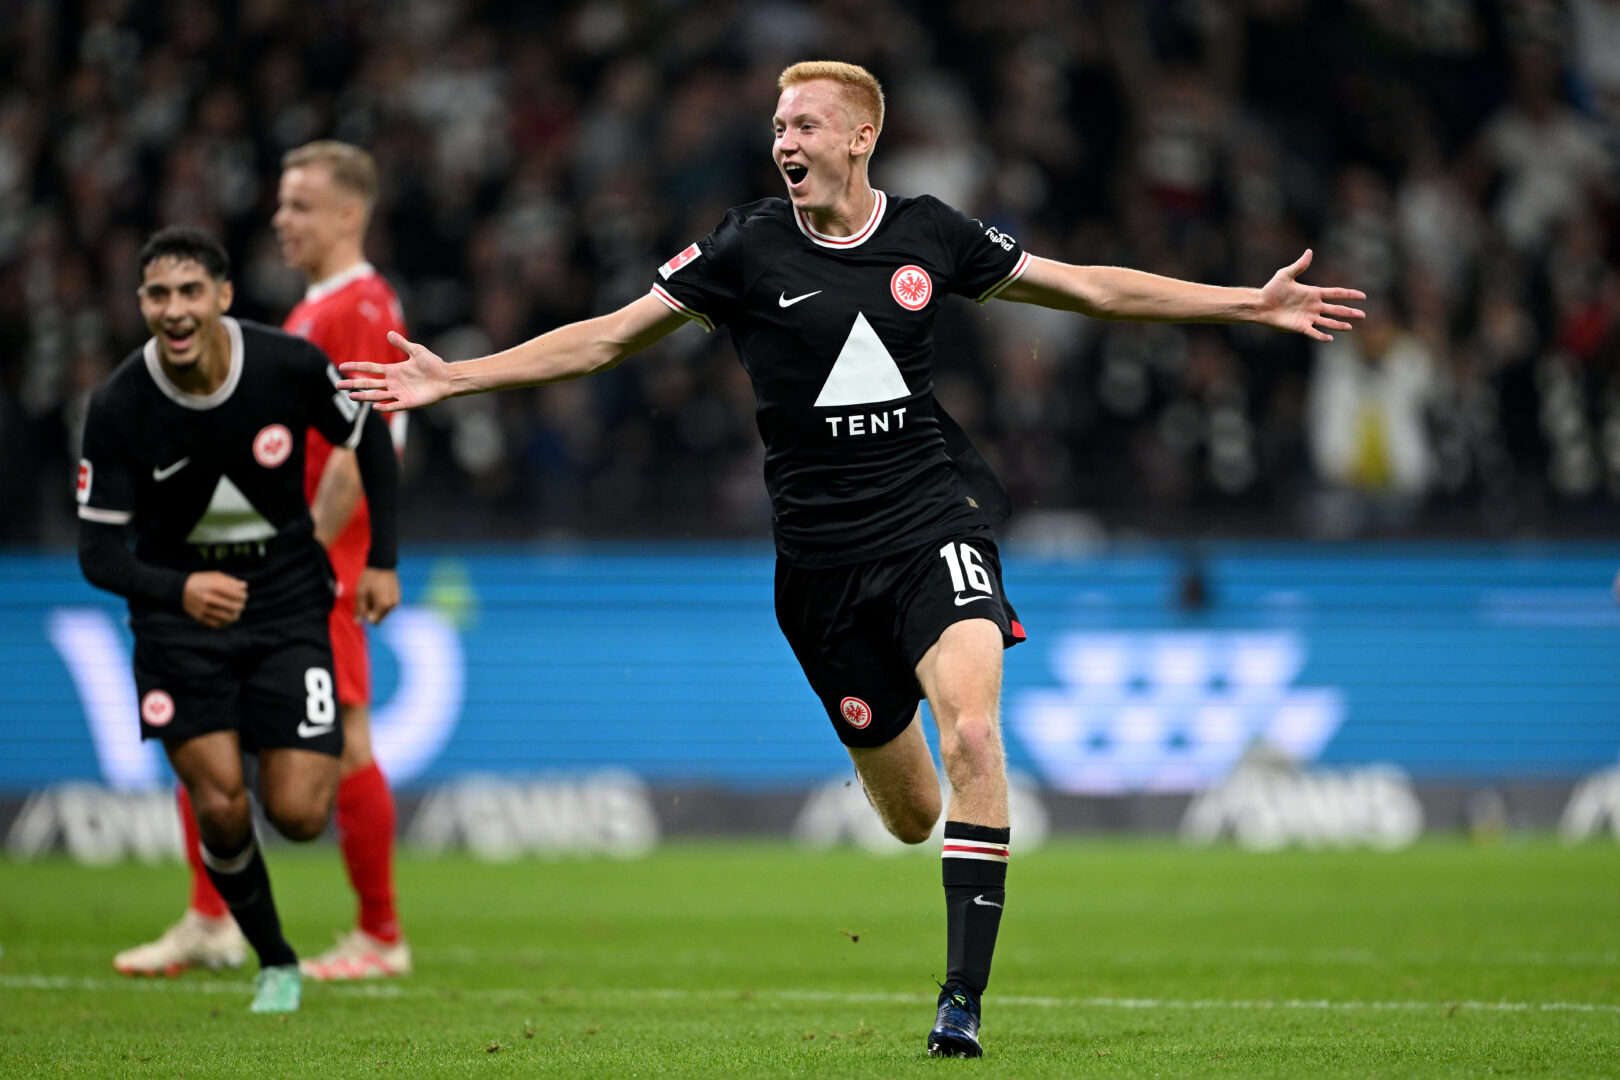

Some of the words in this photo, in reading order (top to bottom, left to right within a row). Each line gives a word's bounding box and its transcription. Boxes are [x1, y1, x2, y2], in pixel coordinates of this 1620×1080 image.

[825, 407, 907, 437] TENT
[940, 541, 993, 595] 16
[304, 667, 336, 725] 8
